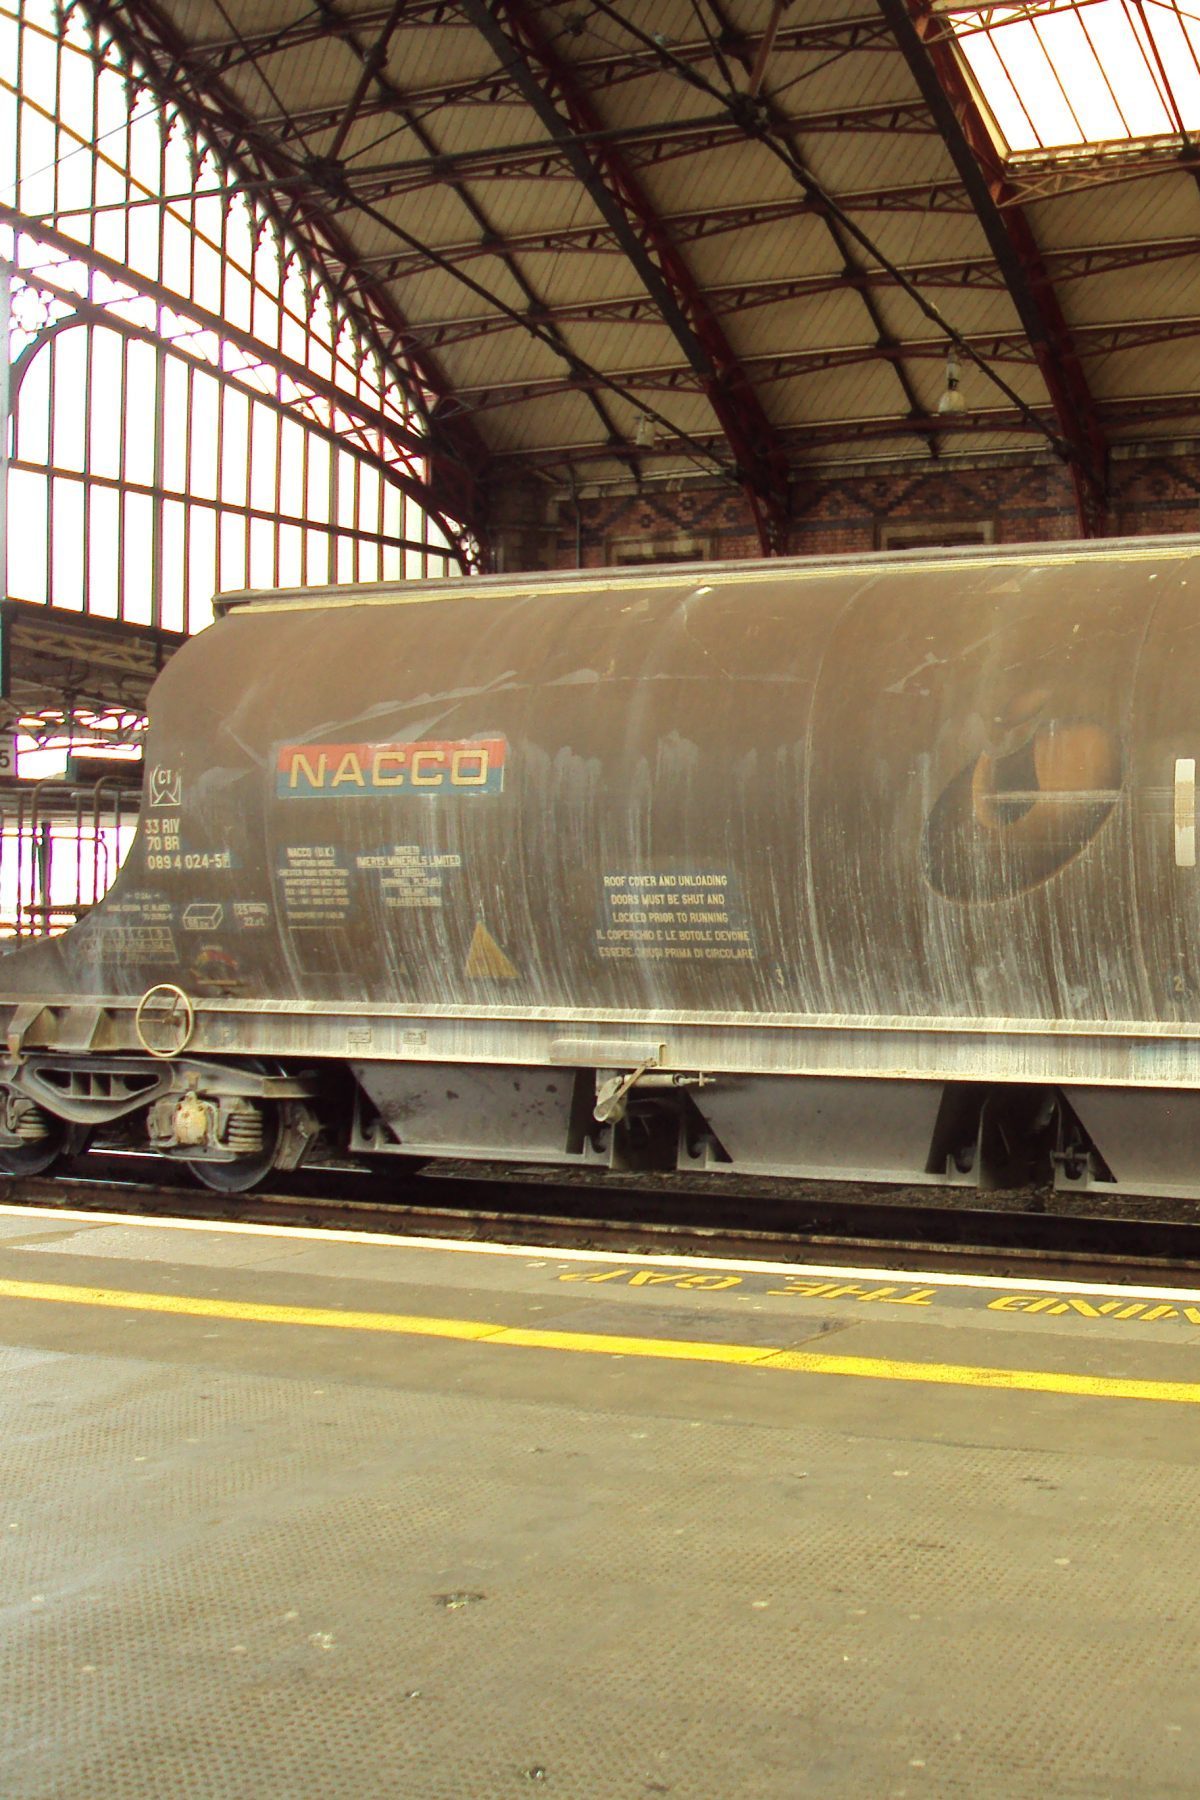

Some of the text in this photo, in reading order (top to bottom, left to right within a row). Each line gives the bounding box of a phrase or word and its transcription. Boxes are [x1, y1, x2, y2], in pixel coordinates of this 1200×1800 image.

[289, 750, 488, 788] NACCO
[145, 819, 180, 834] 33 RIV
[147, 836, 179, 850] 70 BR
[147, 855, 171, 869] 089
[174, 855, 181, 869] 4
[604, 875, 727, 886] ROOF COVER AND UNLOADING
[611, 894, 725, 905] DOORS MUST BE SHUT AND
[613, 912, 729, 923] LOCKED PRIOR TO RUNNING
[665, 931, 677, 940] LE
[679, 931, 713, 941] BOTOLE
[559, 1270, 743, 1290] GAP
[767, 1281, 938, 1305] THE
